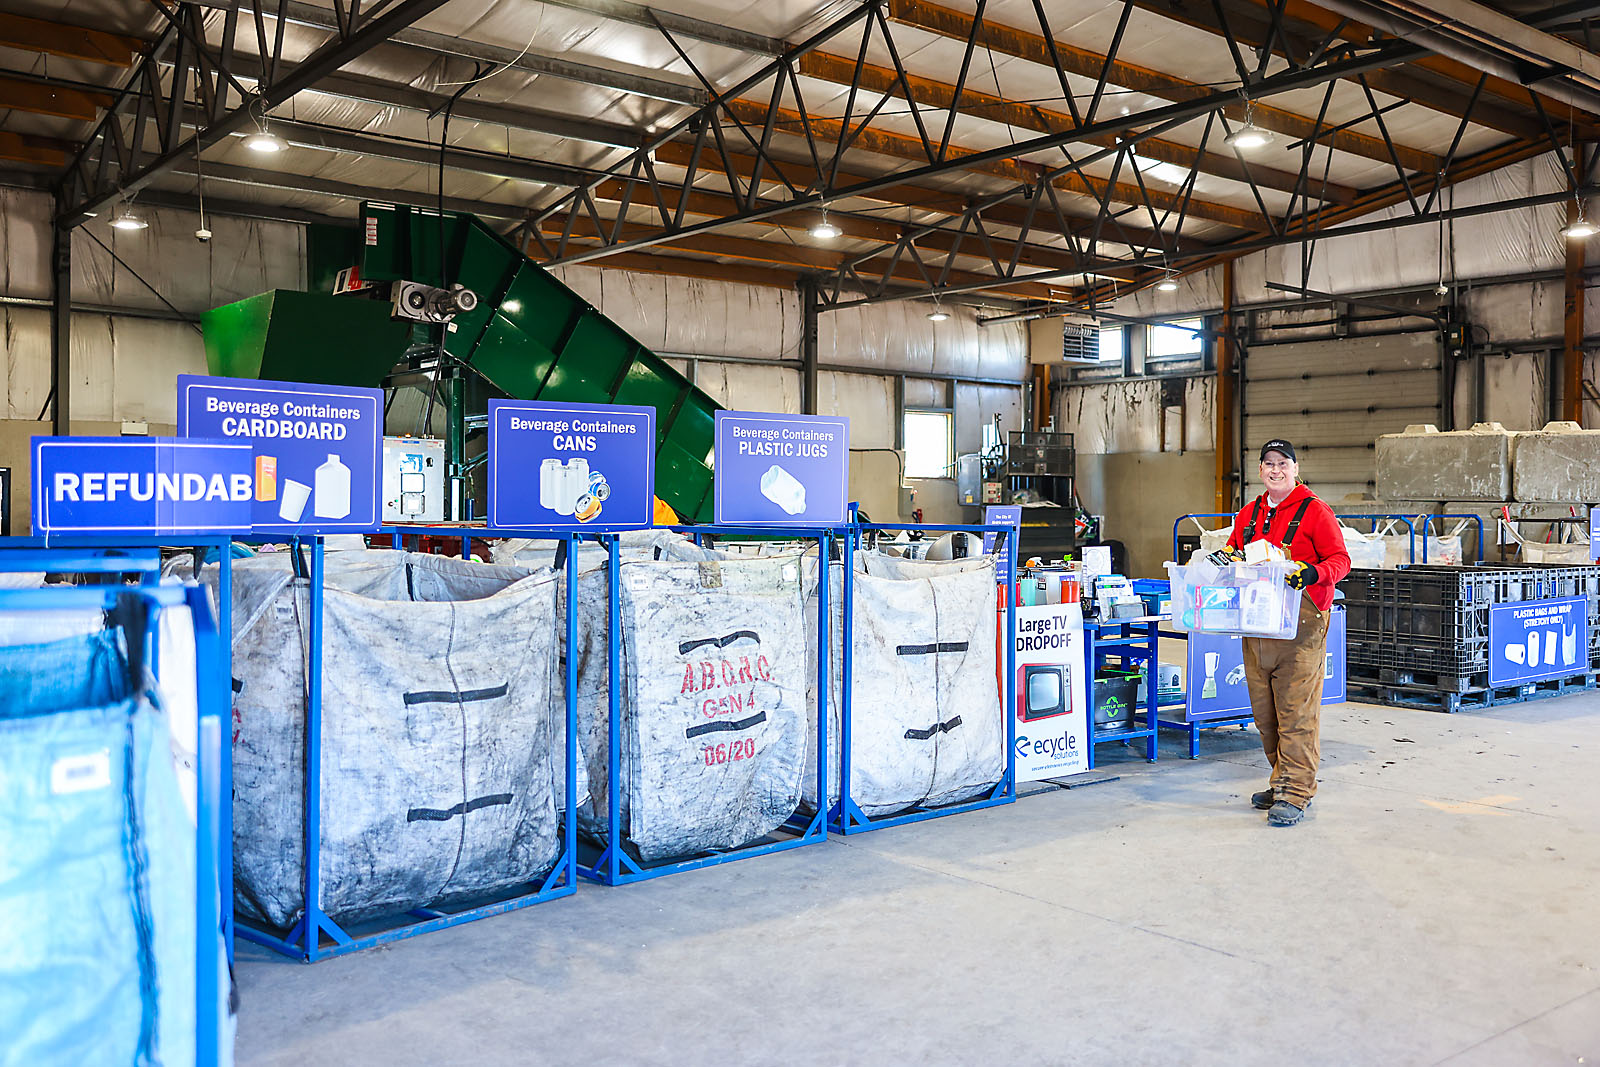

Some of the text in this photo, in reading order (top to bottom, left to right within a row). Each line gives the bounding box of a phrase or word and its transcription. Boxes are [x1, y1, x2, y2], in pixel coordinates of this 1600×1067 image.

[207, 397, 361, 420] Beverage Containers
[222, 417, 347, 440] CARDBOARD
[511, 417, 637, 434] Beverage Containers
[733, 426, 834, 441] Beverage Containers
[553, 435, 597, 451] CANS
[739, 441, 828, 457] PLASTIC JUGS
[55, 473, 253, 501] REFUNDAB
[1513, 604, 1572, 619] PLASTIC BAGS AND WRAP
[1019, 614, 1067, 634] Large TV
[1523, 617, 1549, 629] (STRETCHY
[1016, 632, 1072, 652] DROPOFF
[703, 691, 755, 718] GEN 4
[704, 738, 755, 766] 06/20
[1034, 730, 1076, 758] ecycle
[1054, 750, 1079, 760] solutions
